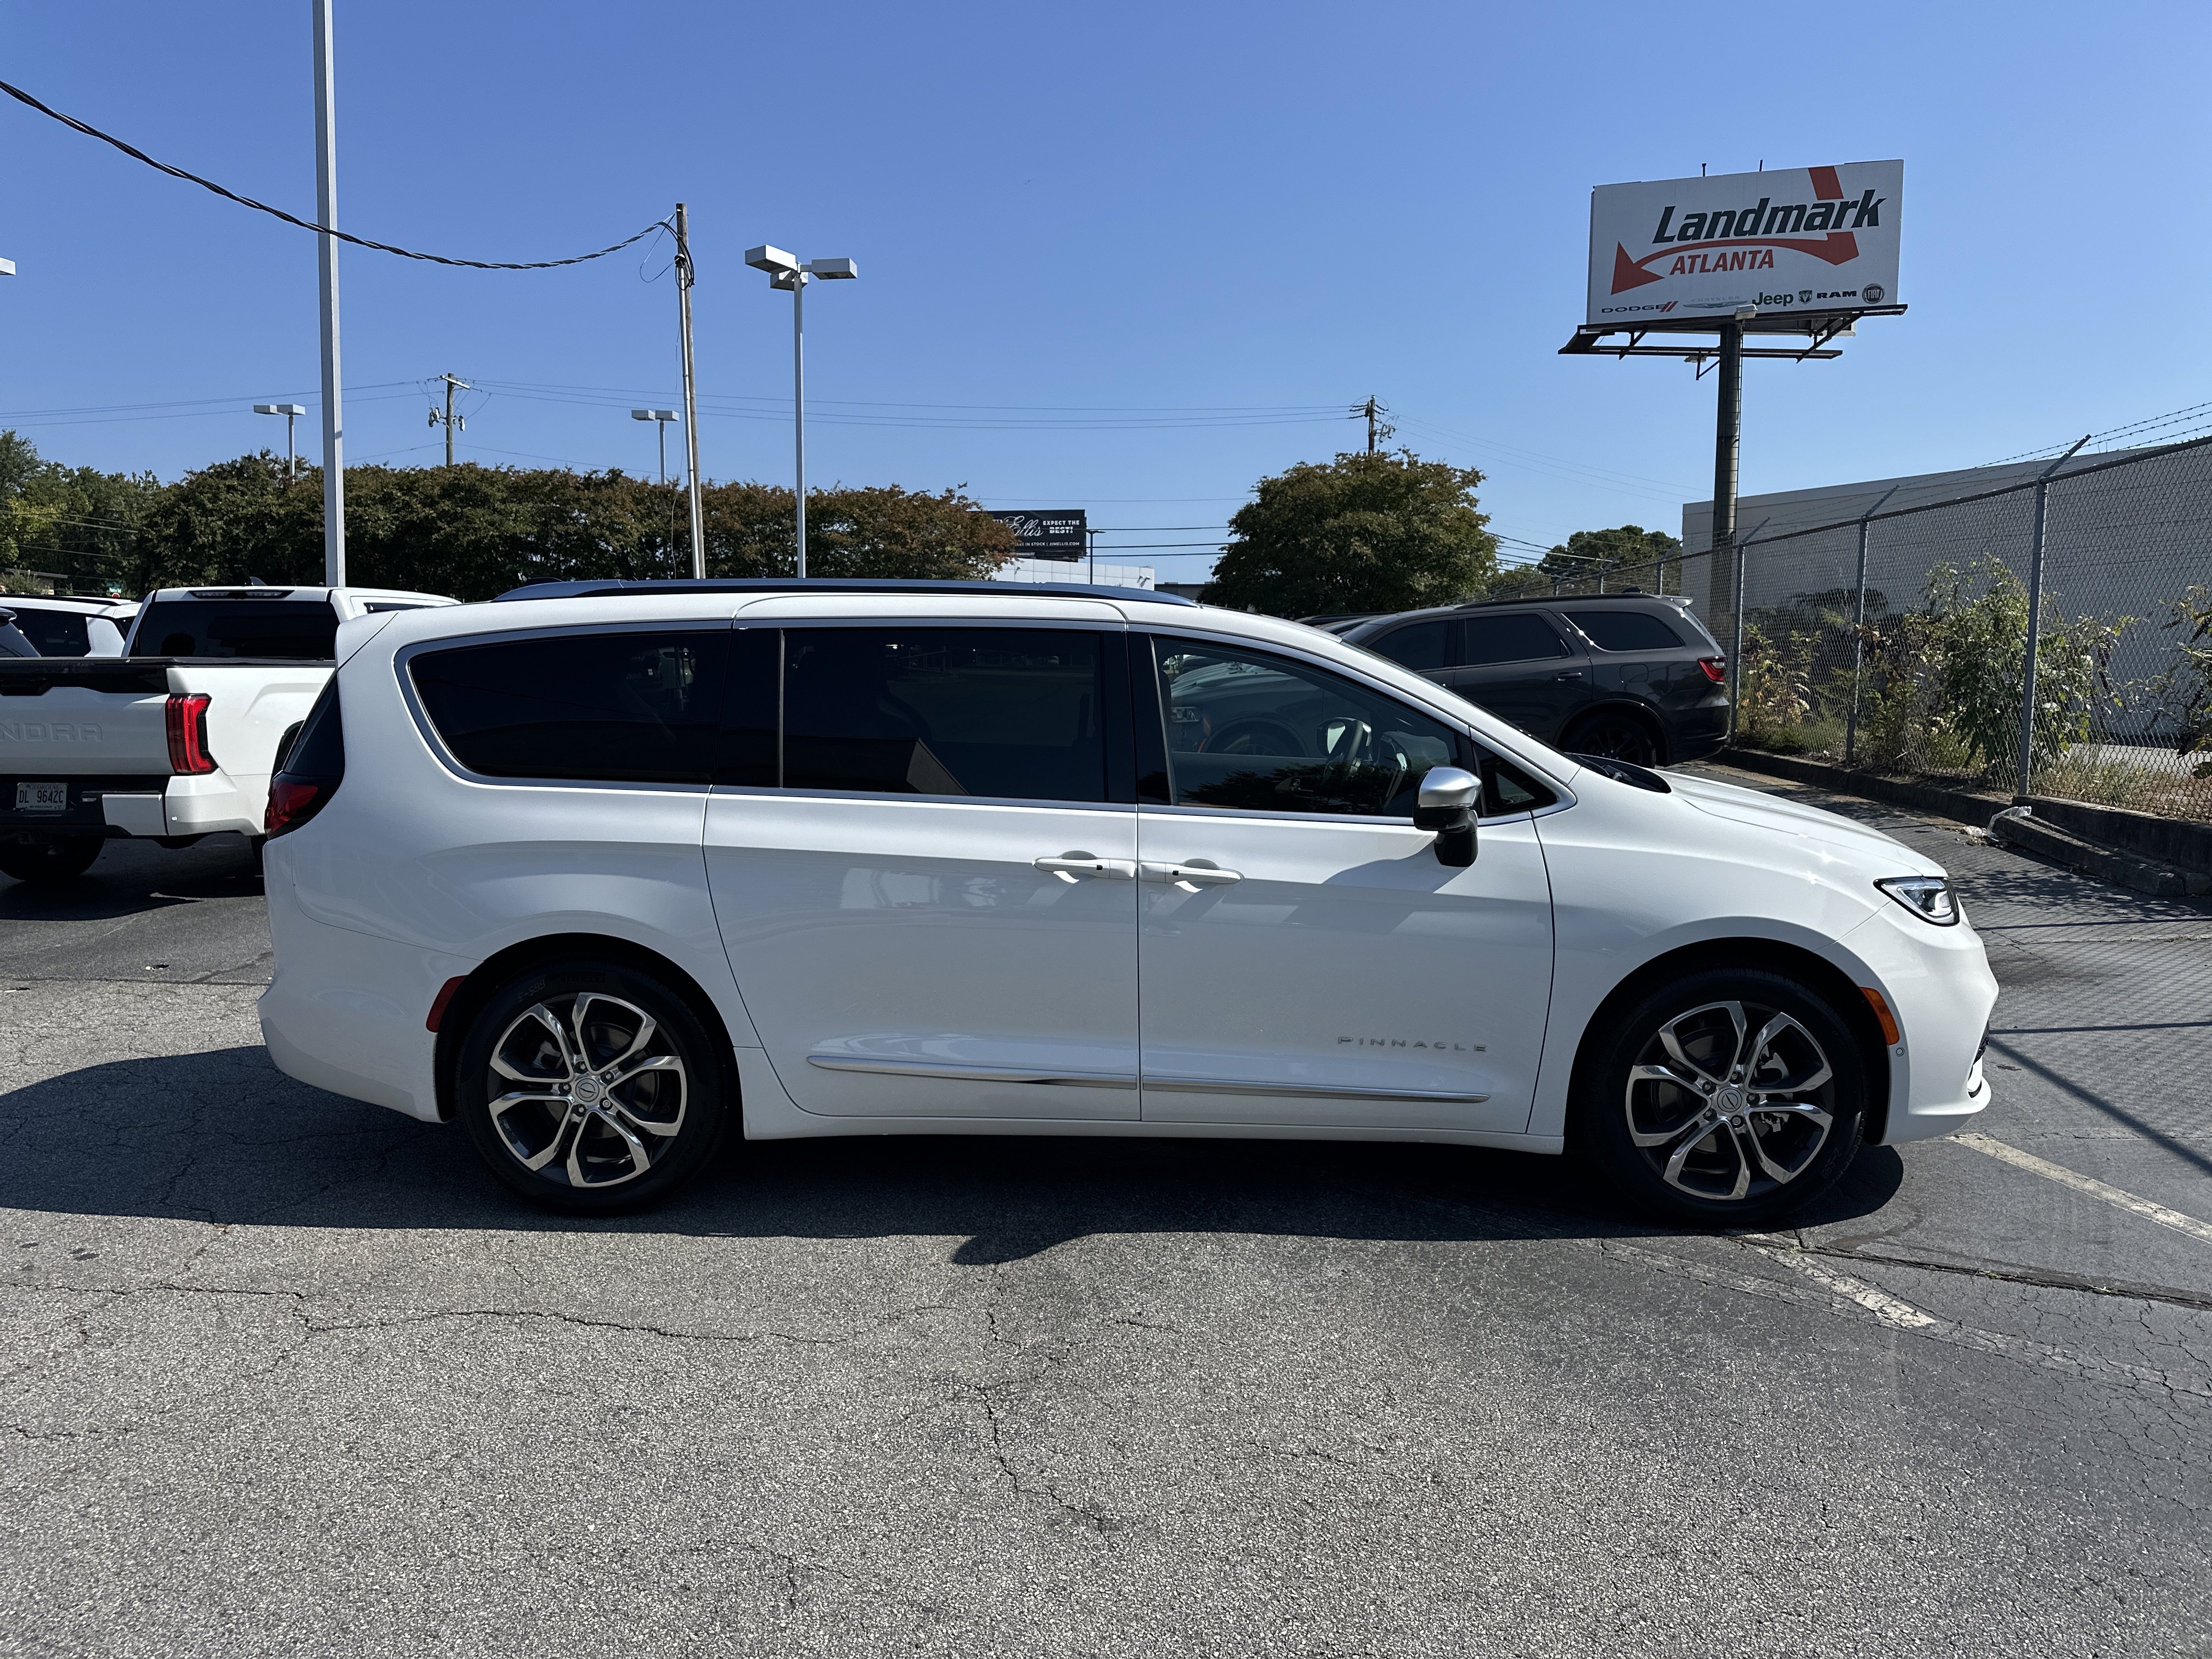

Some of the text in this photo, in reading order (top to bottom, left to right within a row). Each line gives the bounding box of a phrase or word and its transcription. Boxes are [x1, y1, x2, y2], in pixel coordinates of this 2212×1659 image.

[1652, 189, 1887, 244] Landmark
[1669, 249, 1774, 275] ATLANTA
[1752, 292, 1794, 307] Jeep
[1816, 290, 1857, 300] RAM
[1867, 289, 1880, 299] FIAT
[1601, 303, 1663, 313] DODGE
[19, 790, 64, 803] DL 9642C
[1338, 1036, 1487, 1052] PINNACLE
